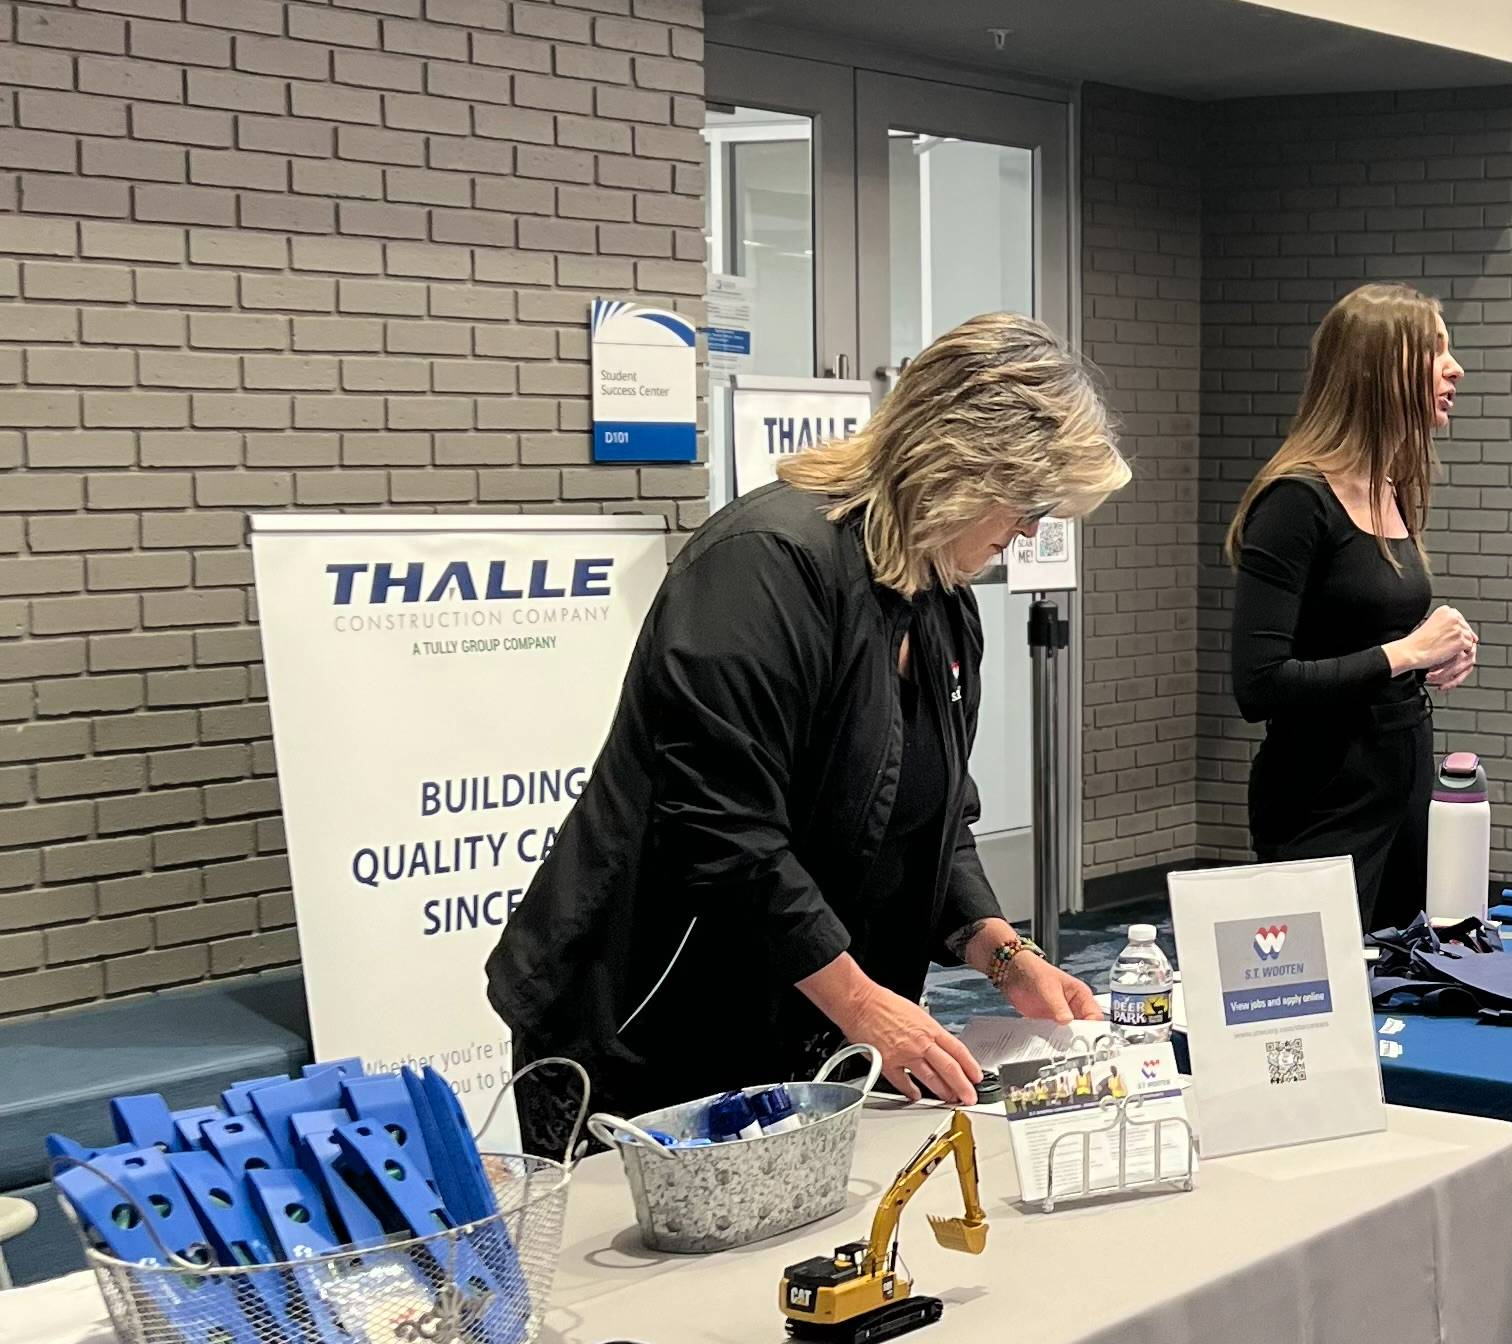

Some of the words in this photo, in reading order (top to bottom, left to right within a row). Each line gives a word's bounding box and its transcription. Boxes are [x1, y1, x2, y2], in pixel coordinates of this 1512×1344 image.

[600, 369, 638, 383] Student
[600, 384, 637, 396] Success
[639, 385, 670, 397] Center
[604, 431, 630, 444] D101
[1017, 538, 1033, 548] SCAN
[1018, 549, 1034, 564] ME!
[325, 558, 614, 606] THALLE
[334, 610, 502, 633] CONSTRUCTION
[512, 605, 611, 625] COMPANY
[412, 642, 421, 656] A
[423, 639, 458, 655] TULLY
[461, 638, 500, 653] GROUP
[503, 636, 557, 651] COMPANY
[421, 766, 588, 816] BUILDING
[352, 831, 508, 887] QUALITY
[517, 826, 560, 863] CA
[423, 888, 524, 936] SINCE
[1244, 967, 1261, 981] S.T.
[1262, 963, 1305, 979] WOOTEN
[1112, 999, 1145, 1012] DEER
[1229, 1000, 1250, 1013] View
[1250, 999, 1267, 1012] jobs
[1267, 996, 1282, 1008] and
[1282, 994, 1302, 1007] apply
[1303, 991, 1325, 1003] online
[1113, 1011, 1148, 1025] PARK
[440, 1041, 493, 1072] you're
[450, 1078, 471, 1096] ou
[476, 1071, 495, 1089] to
[790, 1286, 813, 1307] CAT
